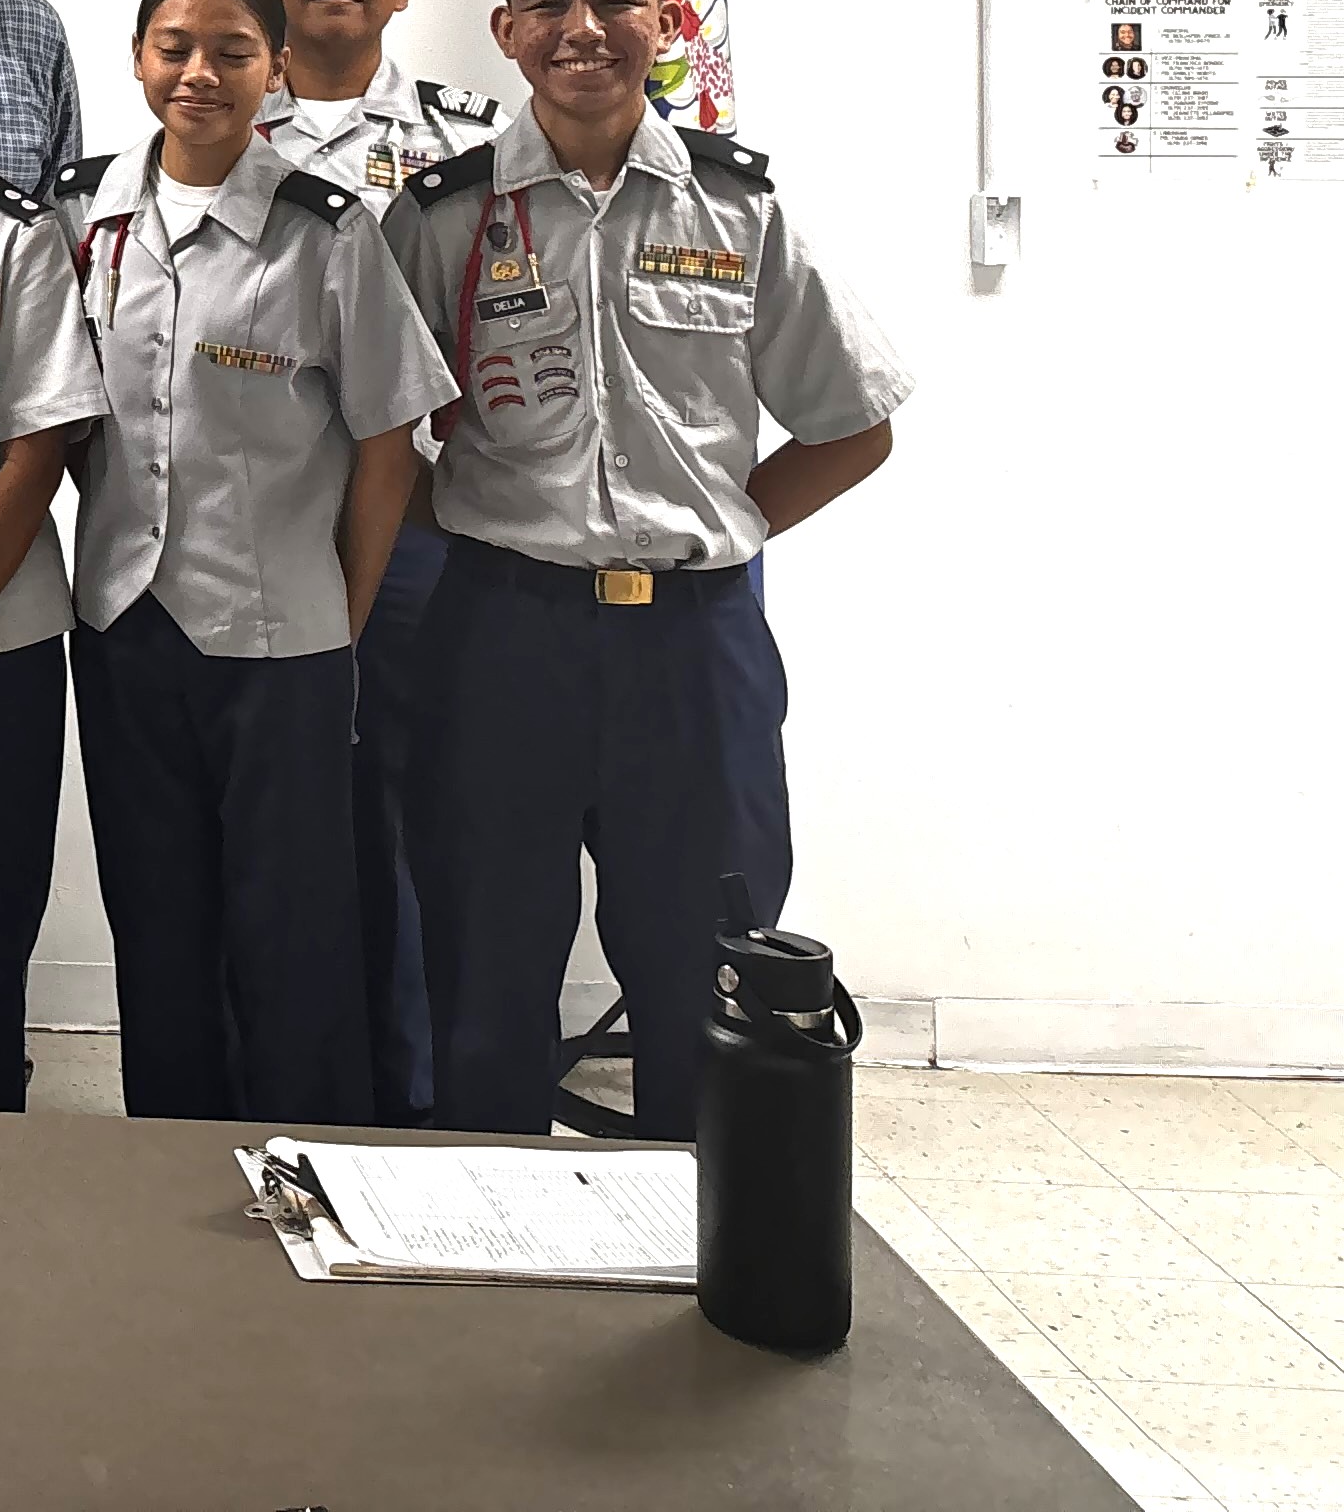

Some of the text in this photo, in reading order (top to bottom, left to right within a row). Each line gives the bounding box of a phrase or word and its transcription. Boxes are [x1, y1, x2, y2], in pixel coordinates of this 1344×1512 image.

[1111, 6, 1226, 15] INCIDENT COMMANDER
[493, 297, 526, 313] DELIA
